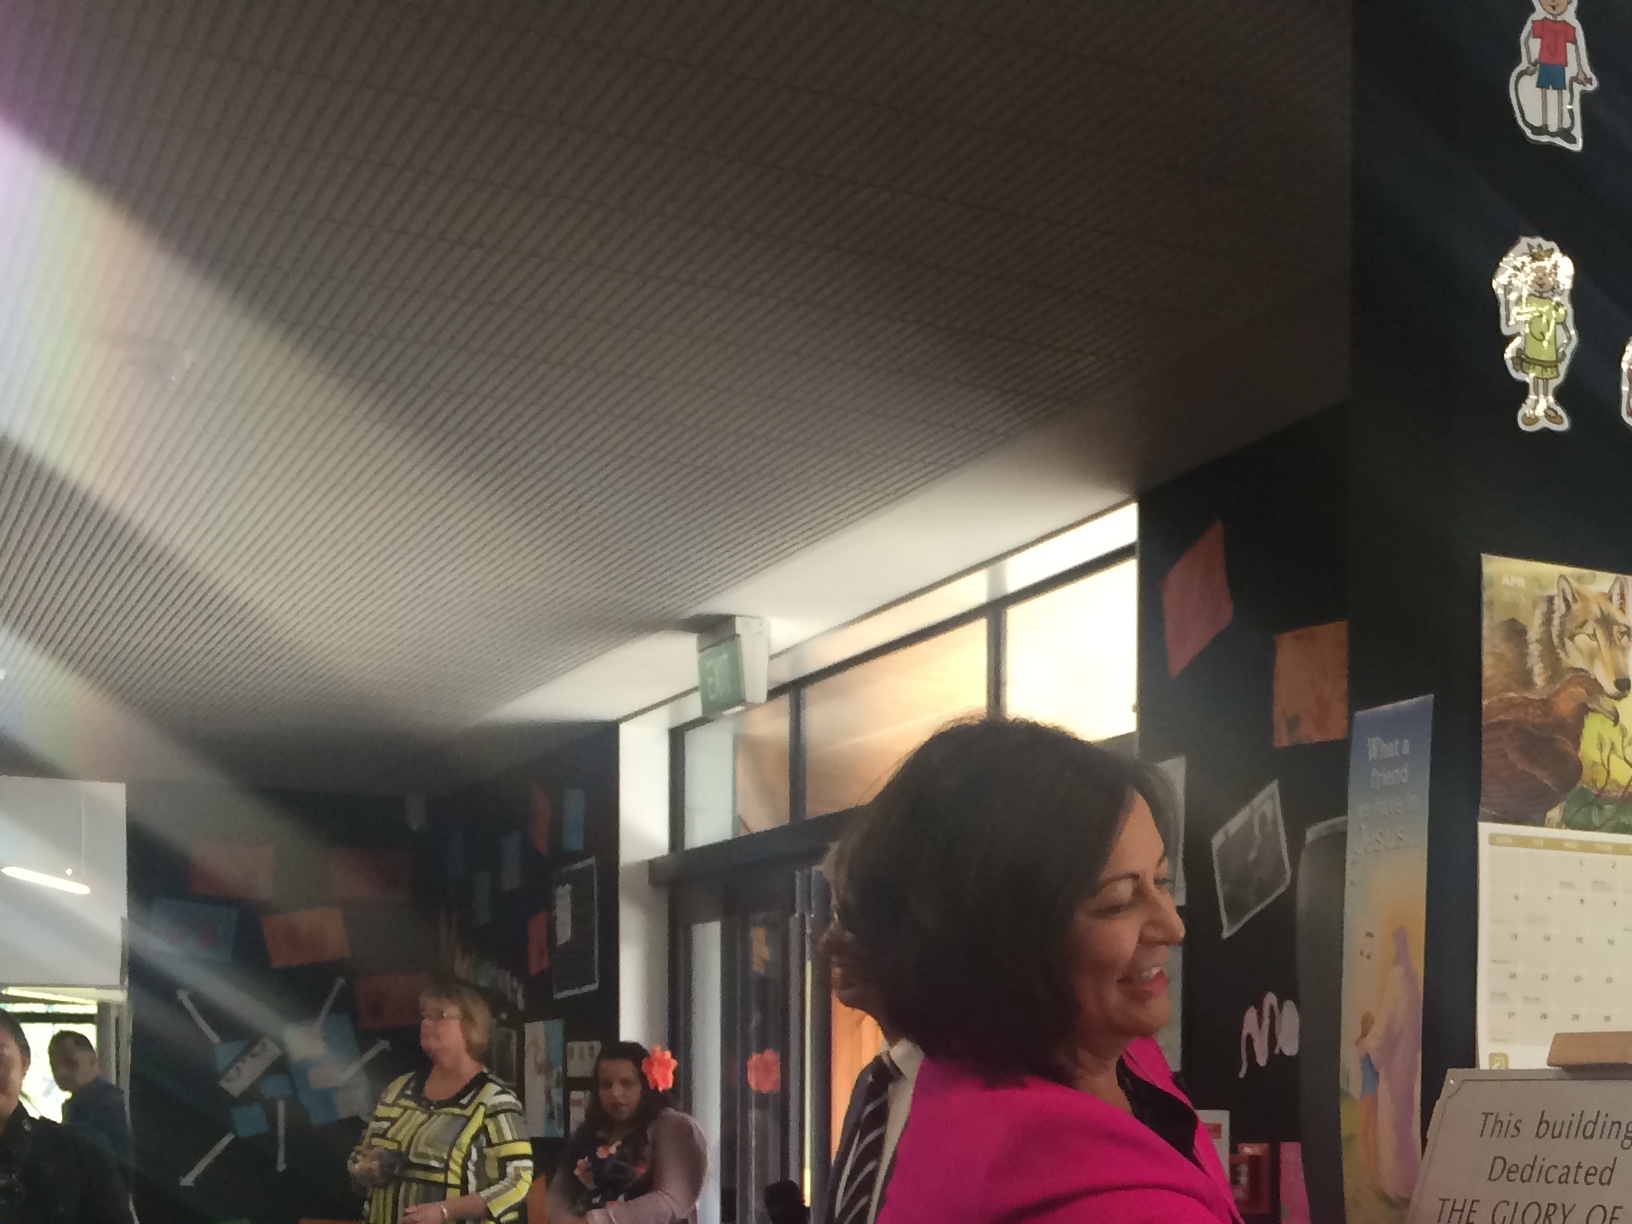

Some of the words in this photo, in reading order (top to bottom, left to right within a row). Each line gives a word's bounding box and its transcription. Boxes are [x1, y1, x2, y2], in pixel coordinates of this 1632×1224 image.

[1501, 575, 1526, 589] APR
[1367, 736, 1400, 762] What
[1478, 1110, 1522, 1140] This
[1487, 1155, 1617, 1188] Dedicated
